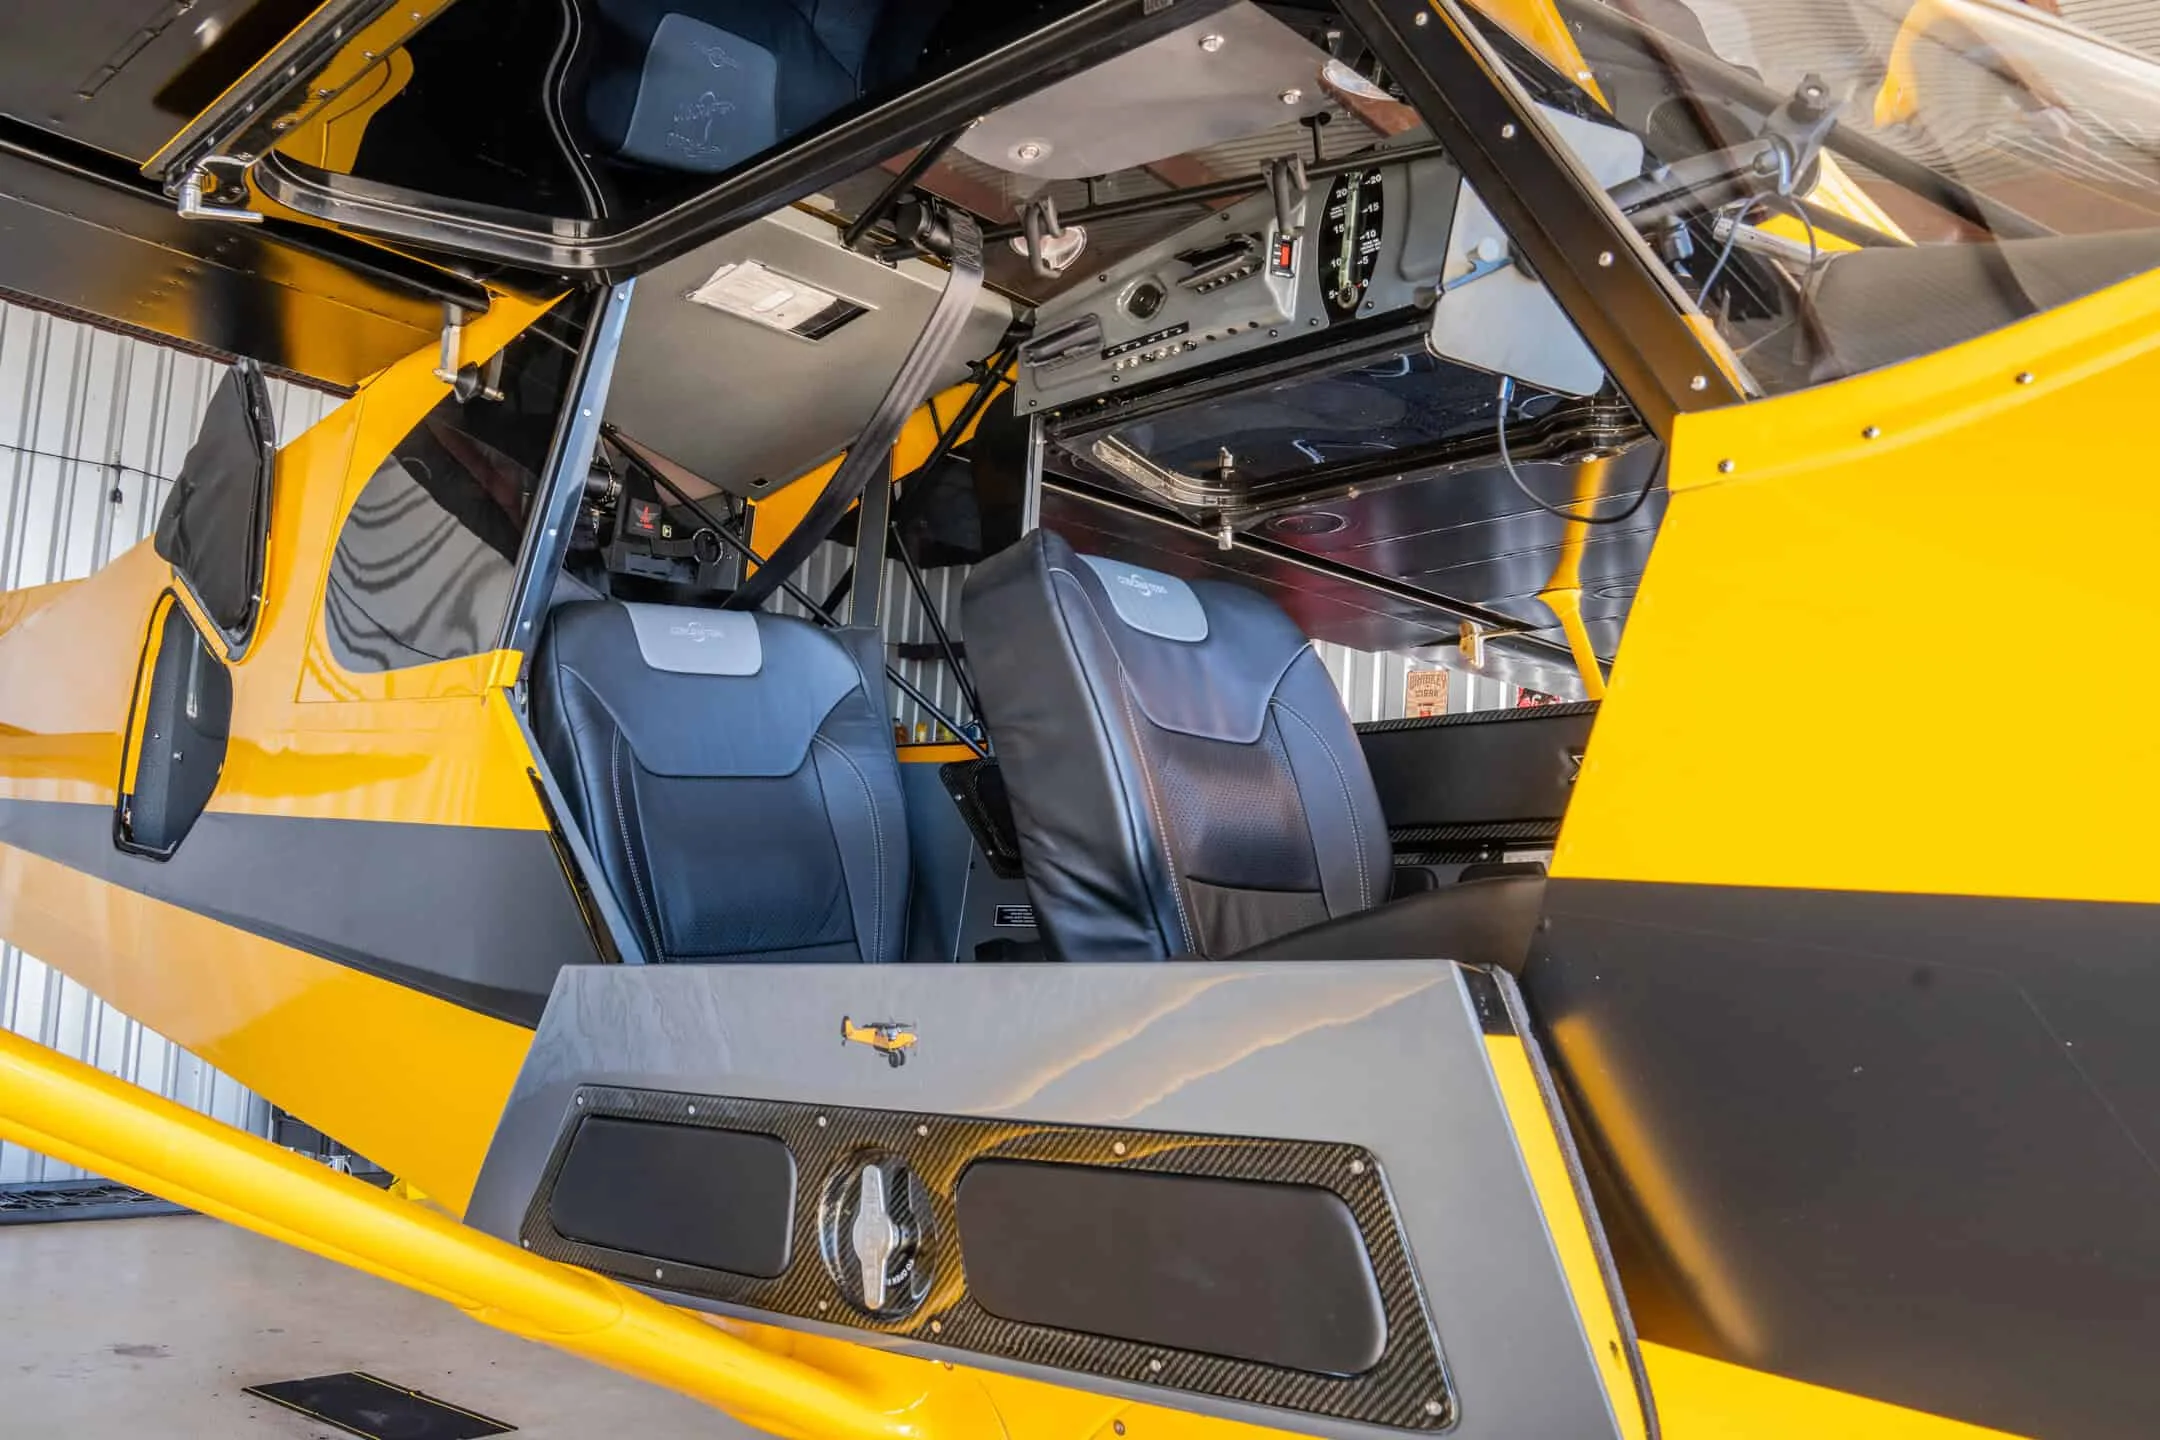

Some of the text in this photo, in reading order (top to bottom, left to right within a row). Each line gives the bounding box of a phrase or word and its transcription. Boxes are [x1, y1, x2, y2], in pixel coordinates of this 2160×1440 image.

[1370, 174, 1382, 184] 20
[1336, 188, 1348, 198] 20
[1368, 202, 1379, 212] 15
[1333, 224, 1345, 233] 15
[1365, 230, 1377, 240] 10
[1331, 257, 1342, 268] 10
